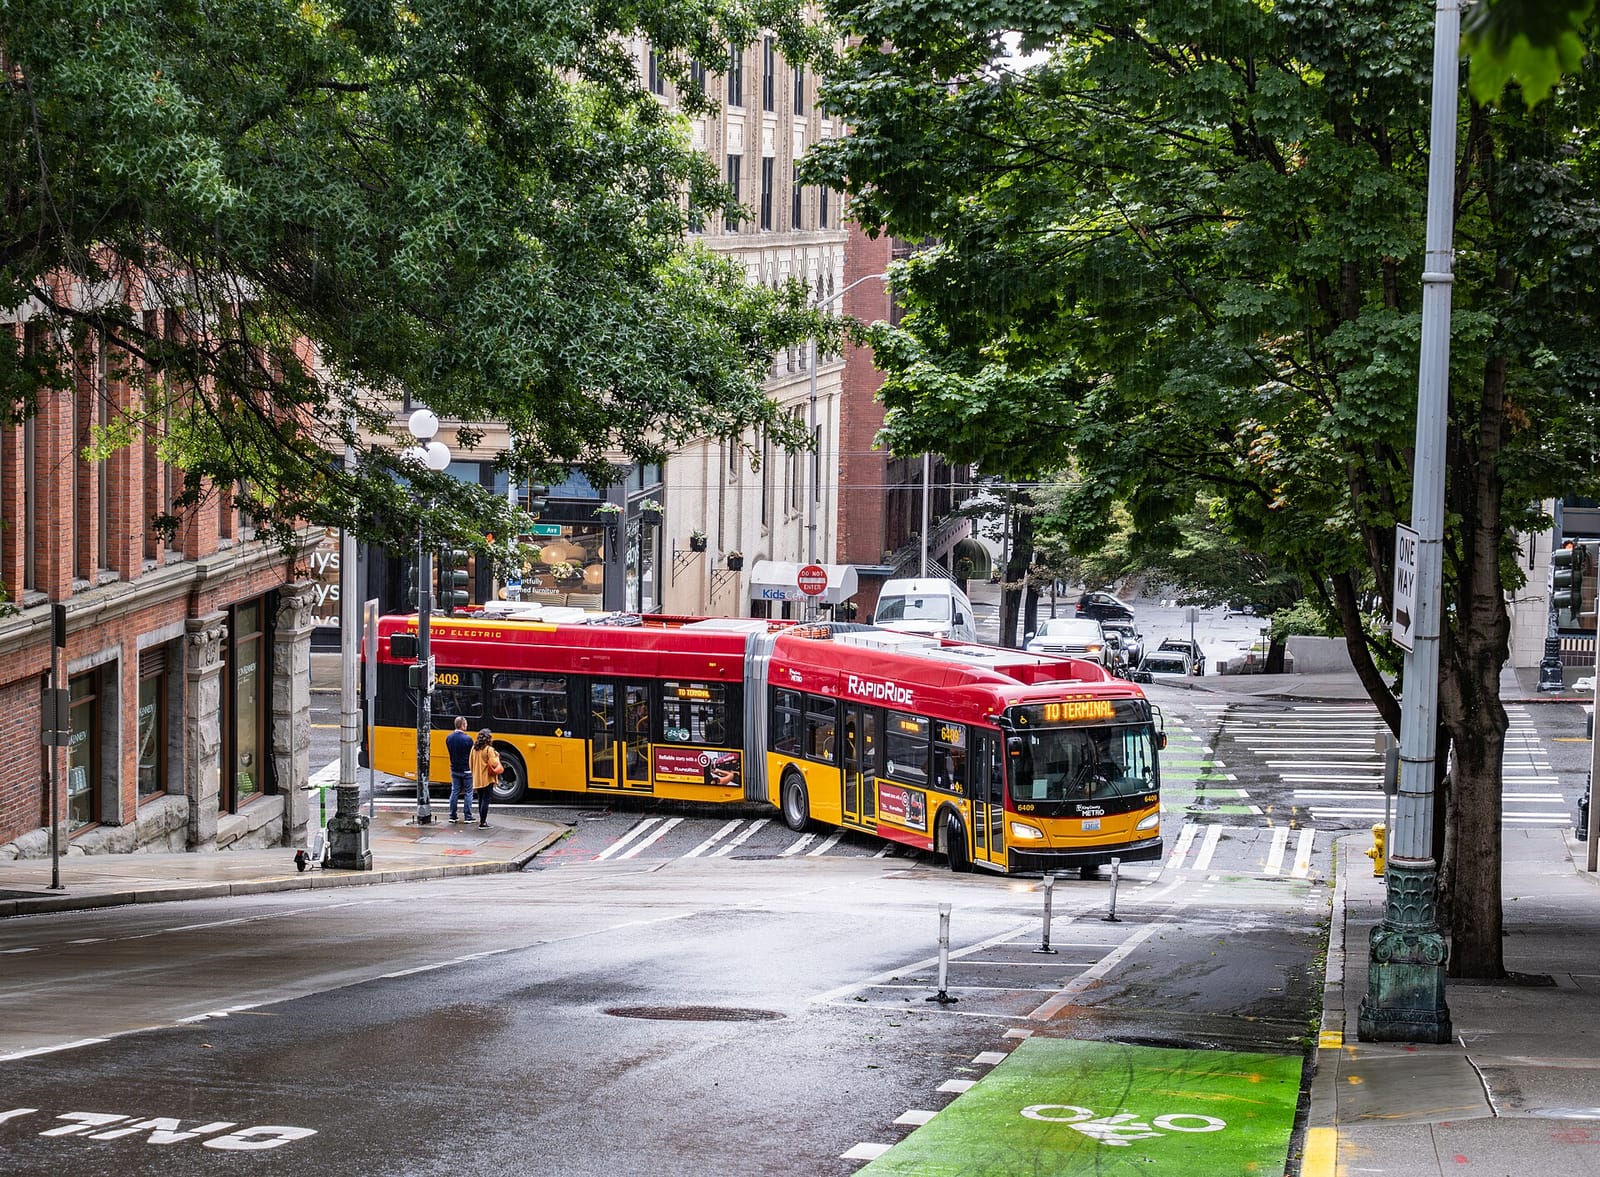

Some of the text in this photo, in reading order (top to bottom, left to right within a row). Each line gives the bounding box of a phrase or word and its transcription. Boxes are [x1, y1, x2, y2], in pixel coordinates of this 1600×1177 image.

[1399, 536, 1415, 567] ONE
[1397, 567, 1415, 598] WAY
[532, 586, 560, 594] furniture
[407, 627, 502, 638] HYRID ELECTRIC
[434, 673, 459, 685] 6409
[1044, 700, 1115, 721] TO TERMINAL
[941, 726, 959, 743] 6409
[1144, 794, 1158, 803] 6409
[1081, 808, 1105, 817] METRO
